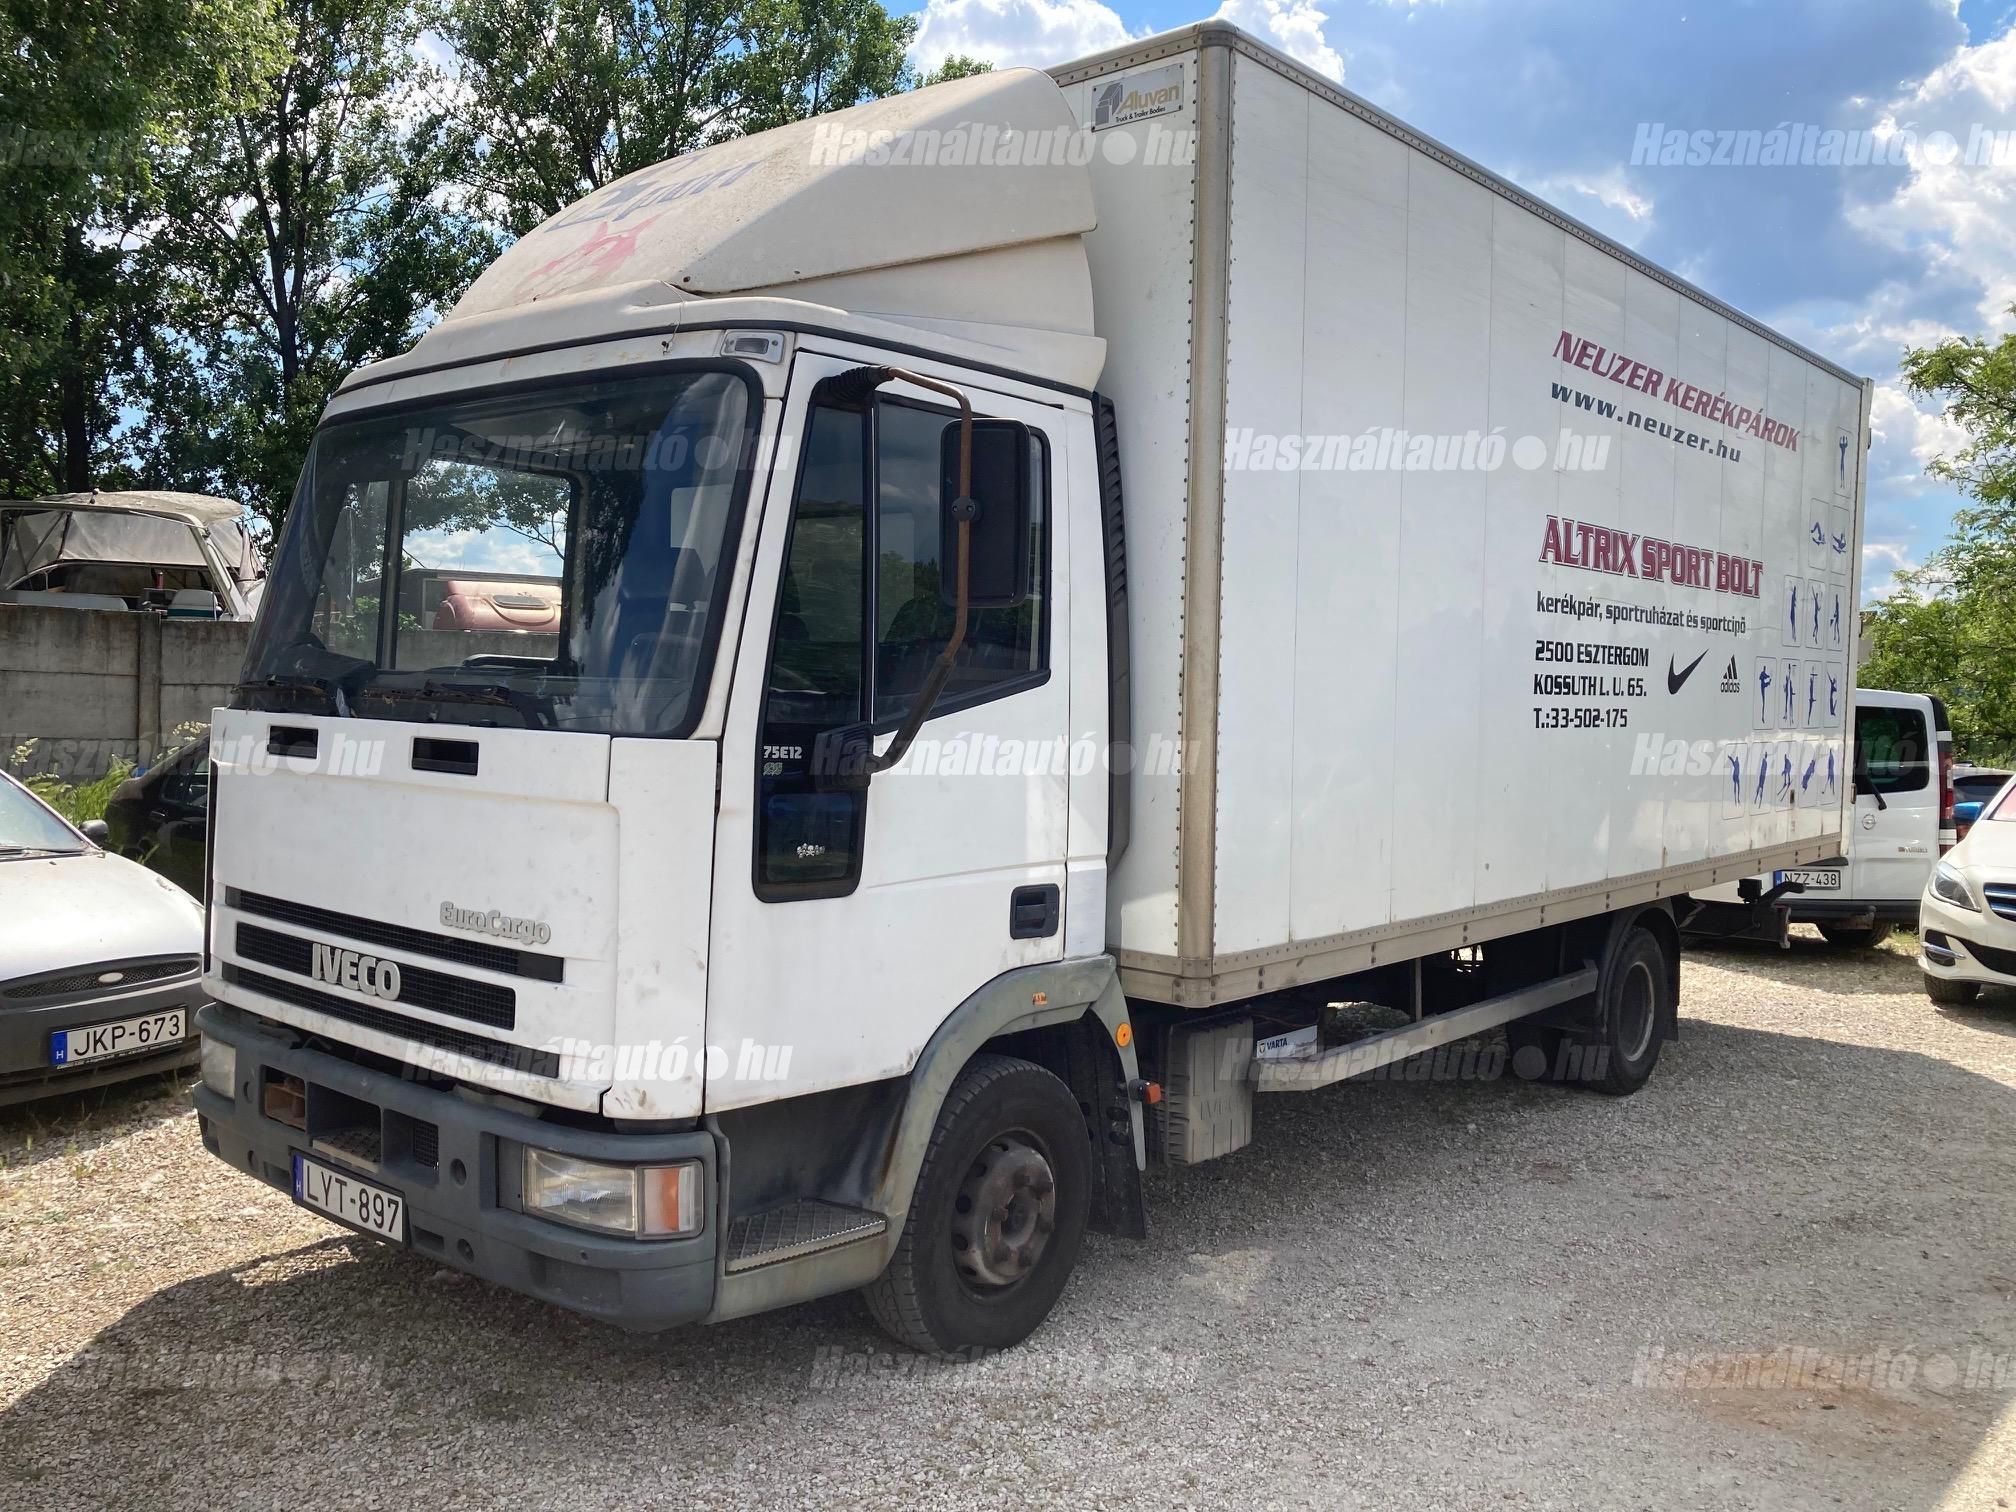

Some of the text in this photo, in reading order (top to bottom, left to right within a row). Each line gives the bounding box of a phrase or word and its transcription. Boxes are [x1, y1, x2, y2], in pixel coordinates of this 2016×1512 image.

[1115, 114, 1128, 123] Truck
[1134, 109, 1149, 119] Trailer
[1149, 105, 1166, 115] Bodies
[1117, 84, 1180, 114] Aluvan
[1552, 330, 1801, 452] NEUZER KERÉKPÁROK
[1551, 381, 1742, 463] www.neuzer.hu
[1538, 514, 1764, 599] ALTRIX SPORT BOLT
[1536, 590, 1603, 622] kerékpár,
[1604, 602, 1685, 627] sportruházat
[1686, 608, 1699, 629] és
[1535, 639, 1650, 667] 2500 ESZTERGOM
[1533, 673, 1647, 697] KOSSUTH L. U. 65.
[1720, 681, 1741, 693] adidas
[1533, 707, 1628, 729] T.:33-502-175
[763, 745, 803, 760] 75E12
[1784, 872, 1838, 886] NZZ-438
[440, 901, 552, 946] EuroCargo
[312, 942, 401, 1001] IVECO
[74, 1014, 180, 1057] JKP-673
[1266, 1037, 1289, 1050] VARTA
[306, 1164, 400, 1233] LYT-897
